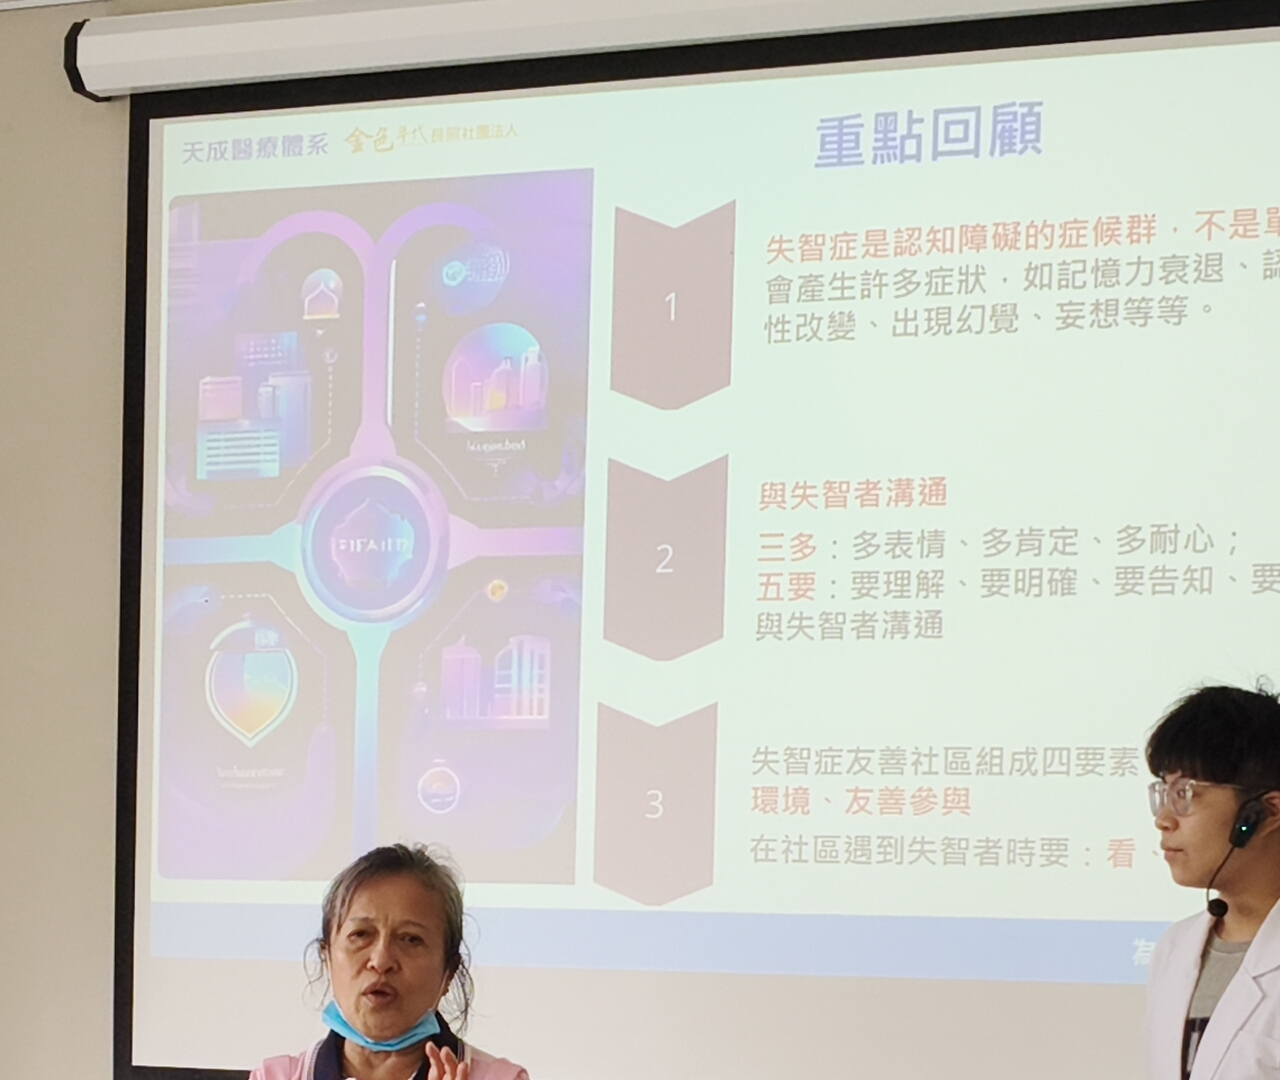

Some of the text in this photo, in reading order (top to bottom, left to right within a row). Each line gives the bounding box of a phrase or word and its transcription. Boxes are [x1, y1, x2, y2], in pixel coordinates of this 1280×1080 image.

[182, 132, 329, 164] 天成醫療體系
[814, 101, 1044, 169] 重點回顧
[664, 291, 676, 321] 1
[759, 476, 948, 511] 與失智者溝通
[655, 544, 675, 574] 2
[755, 608, 945, 642] 與失智者溝通
[751, 746, 1139, 778] 失智症友善社區組成四要素
[645, 789, 665, 819] 3
[750, 786, 972, 817] 環境、友善參與
